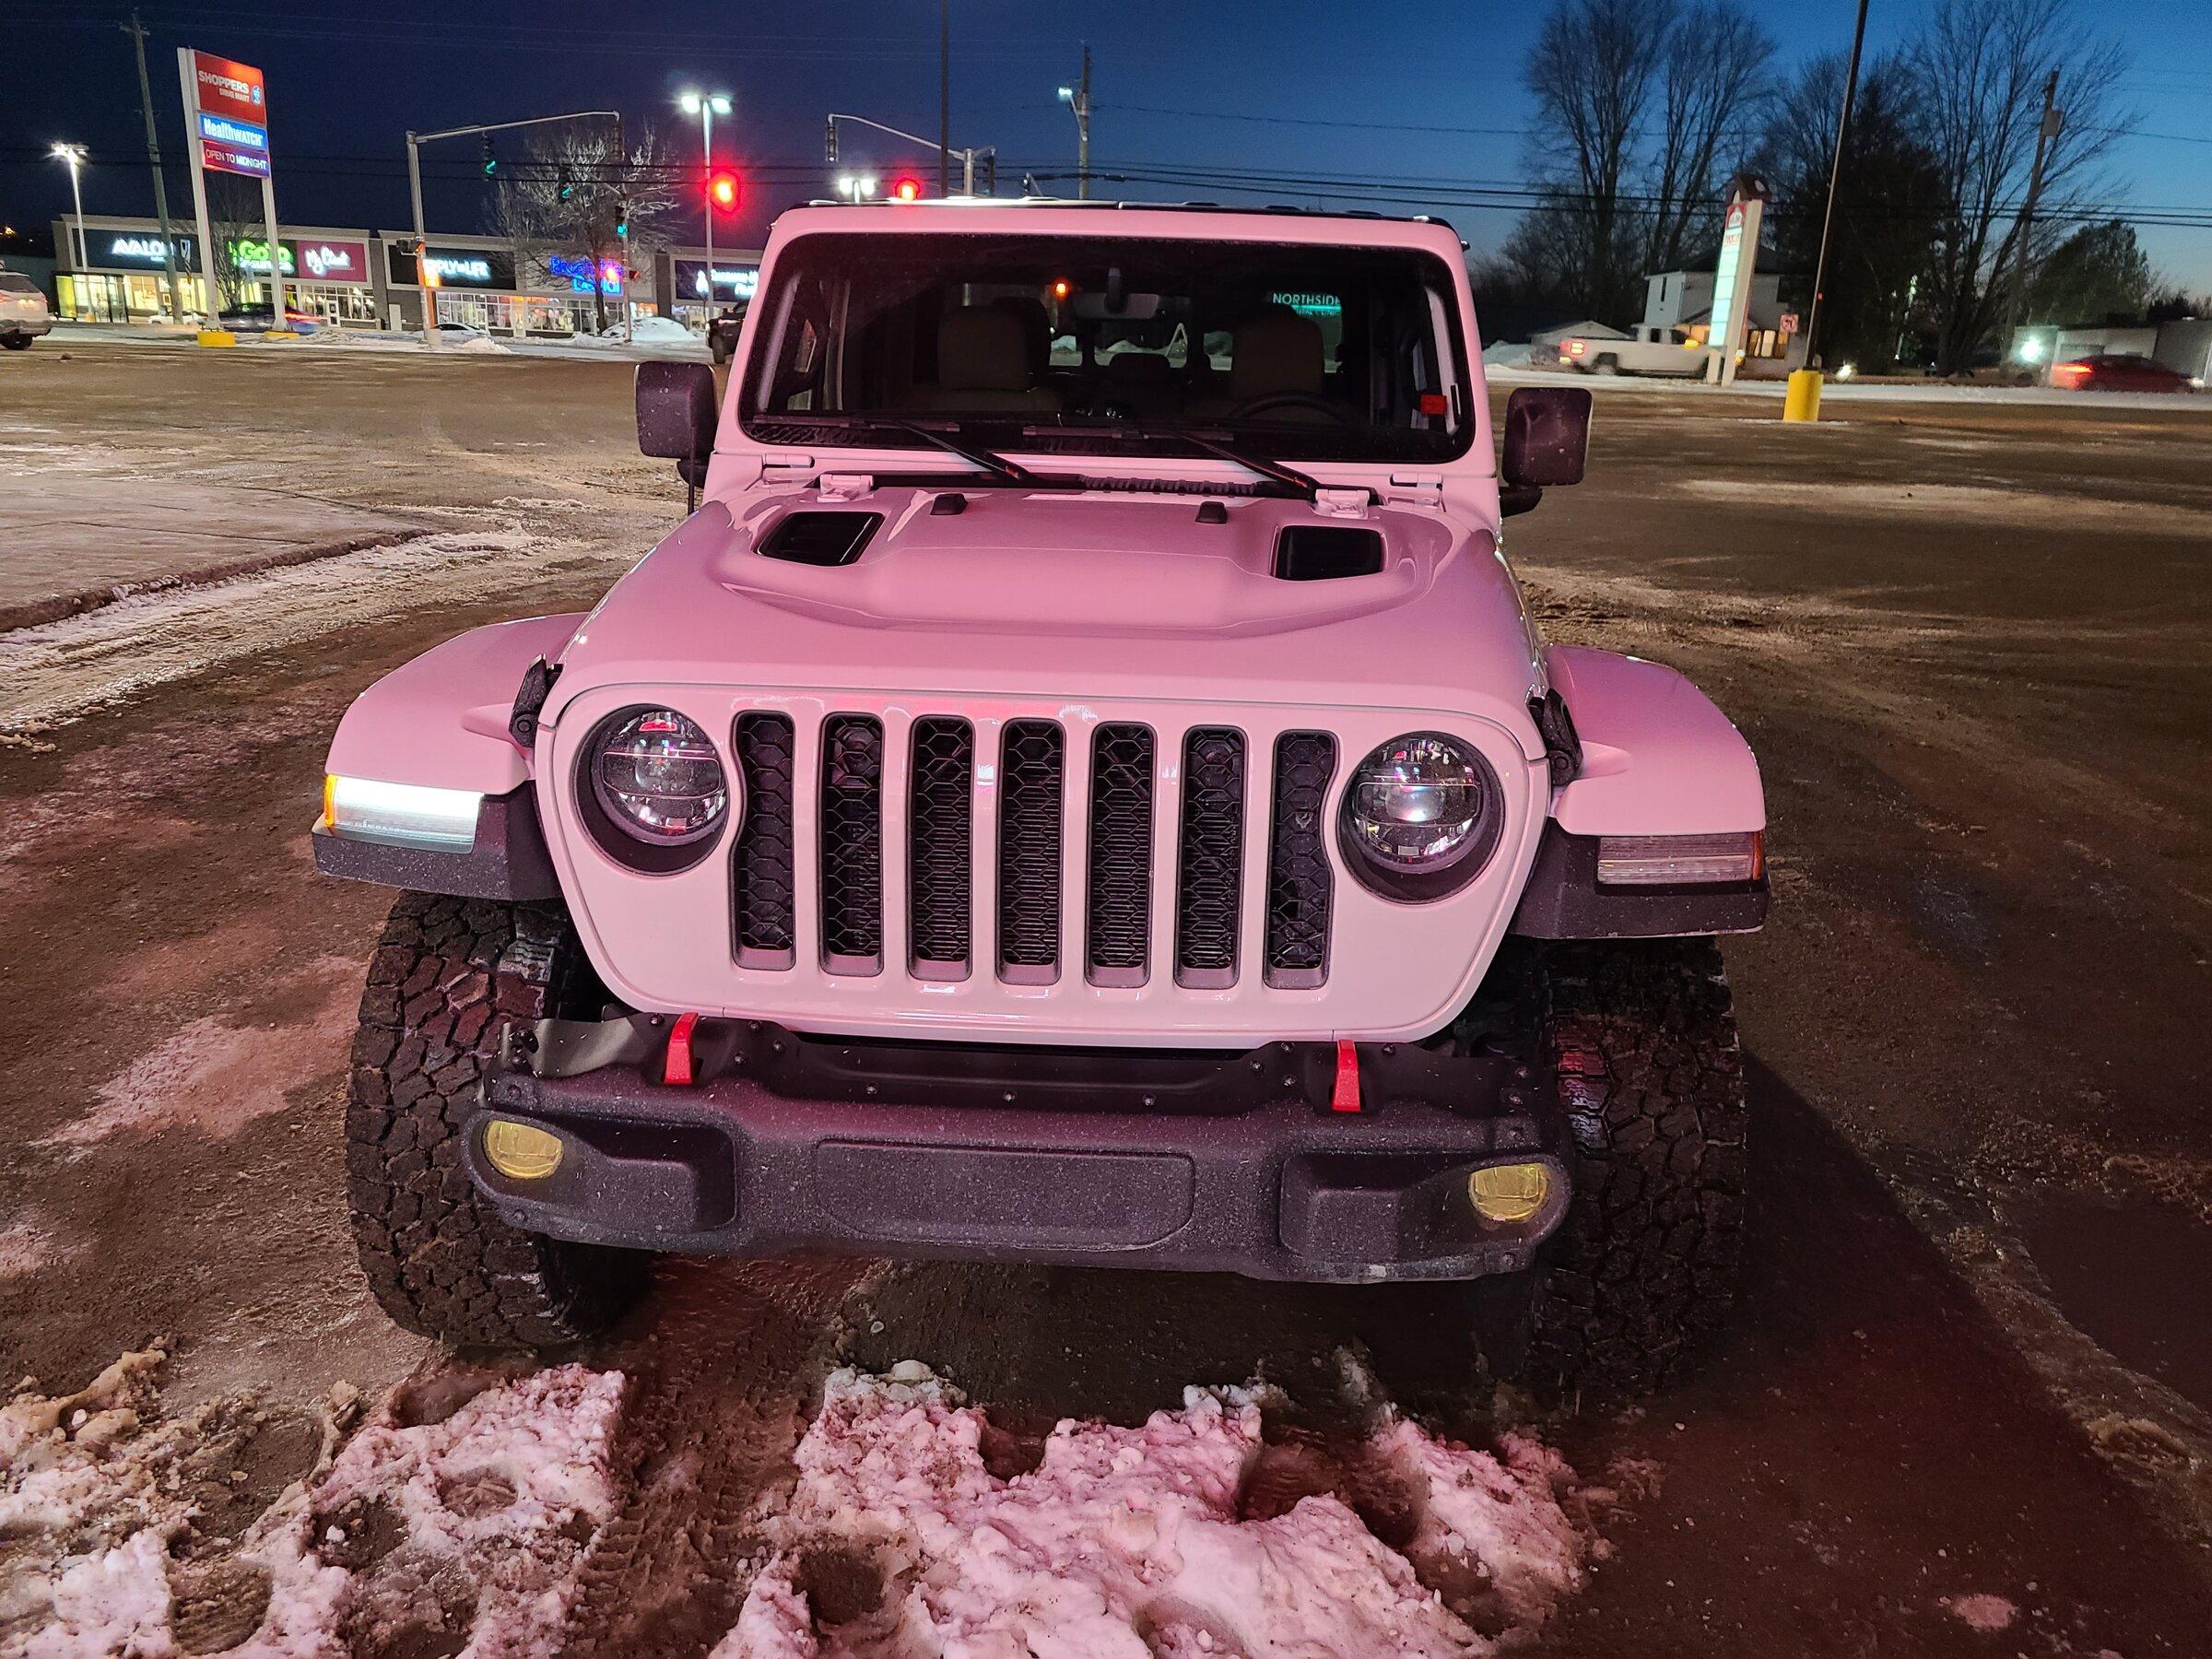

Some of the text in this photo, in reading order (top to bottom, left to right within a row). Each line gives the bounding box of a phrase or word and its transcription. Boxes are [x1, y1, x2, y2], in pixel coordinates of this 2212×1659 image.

[198, 70, 249, 94] SHOPPERS
[206, 149, 266, 170] OPEN TO MIDNIGHT
